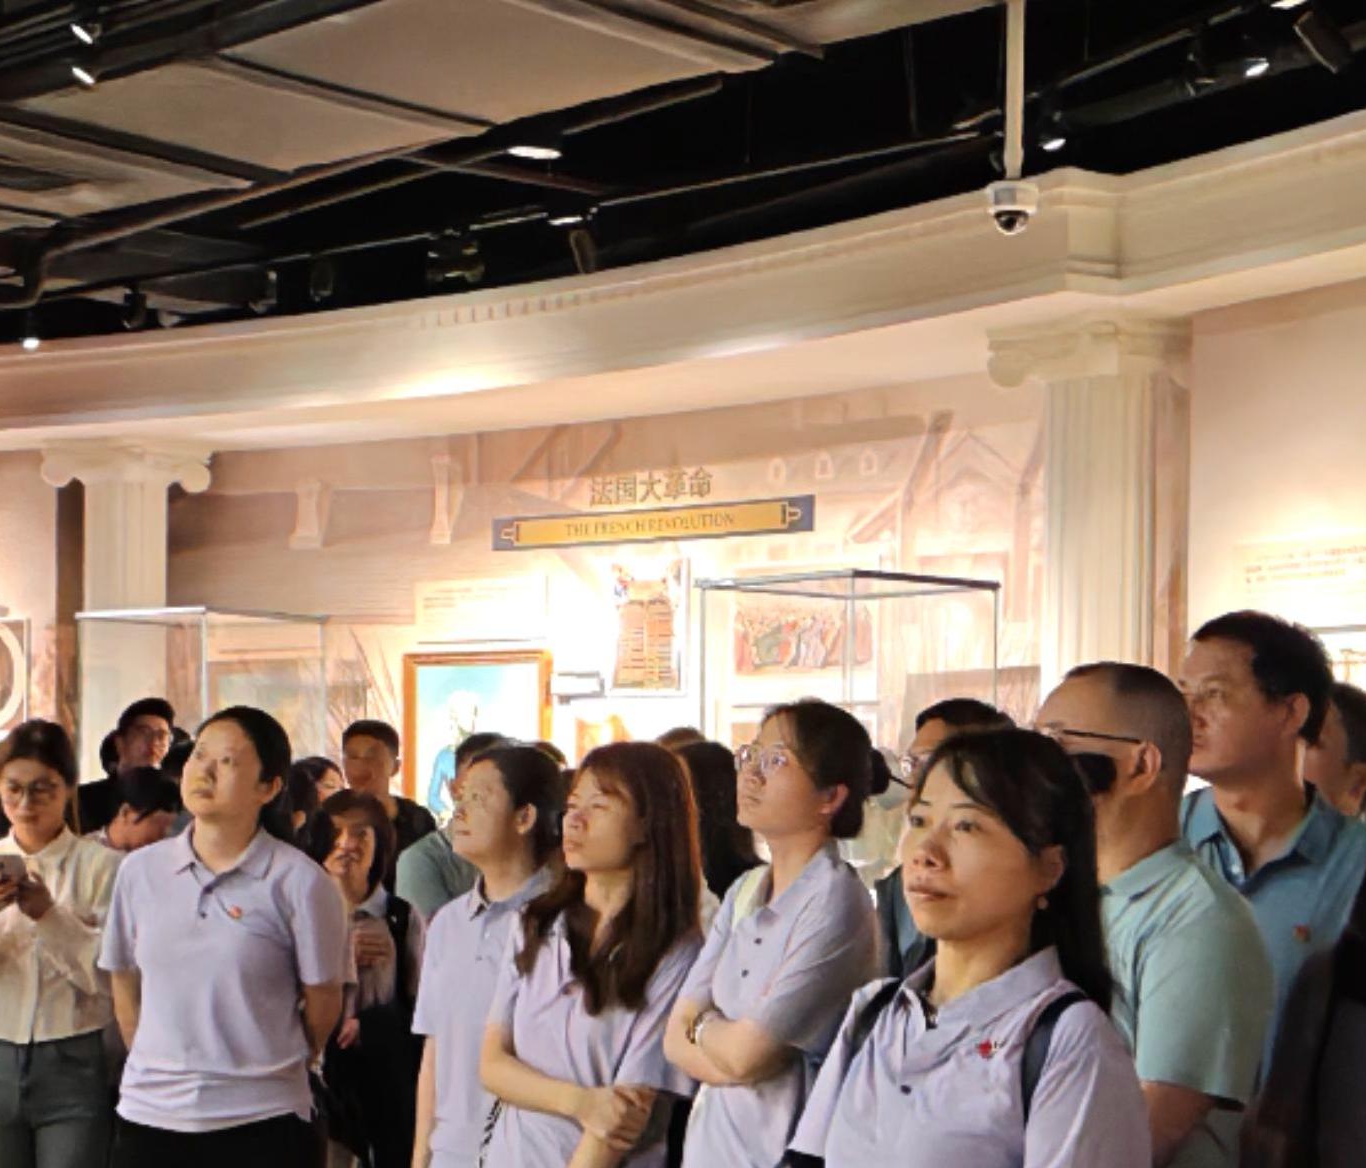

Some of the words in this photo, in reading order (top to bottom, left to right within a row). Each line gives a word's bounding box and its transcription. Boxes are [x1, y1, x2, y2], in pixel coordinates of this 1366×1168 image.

[590, 467, 712, 506] 法国大革命
[565, 522, 591, 538] THE
[593, 518, 646, 536] FRENCH
[647, 512, 735, 533] REVOLUTION
